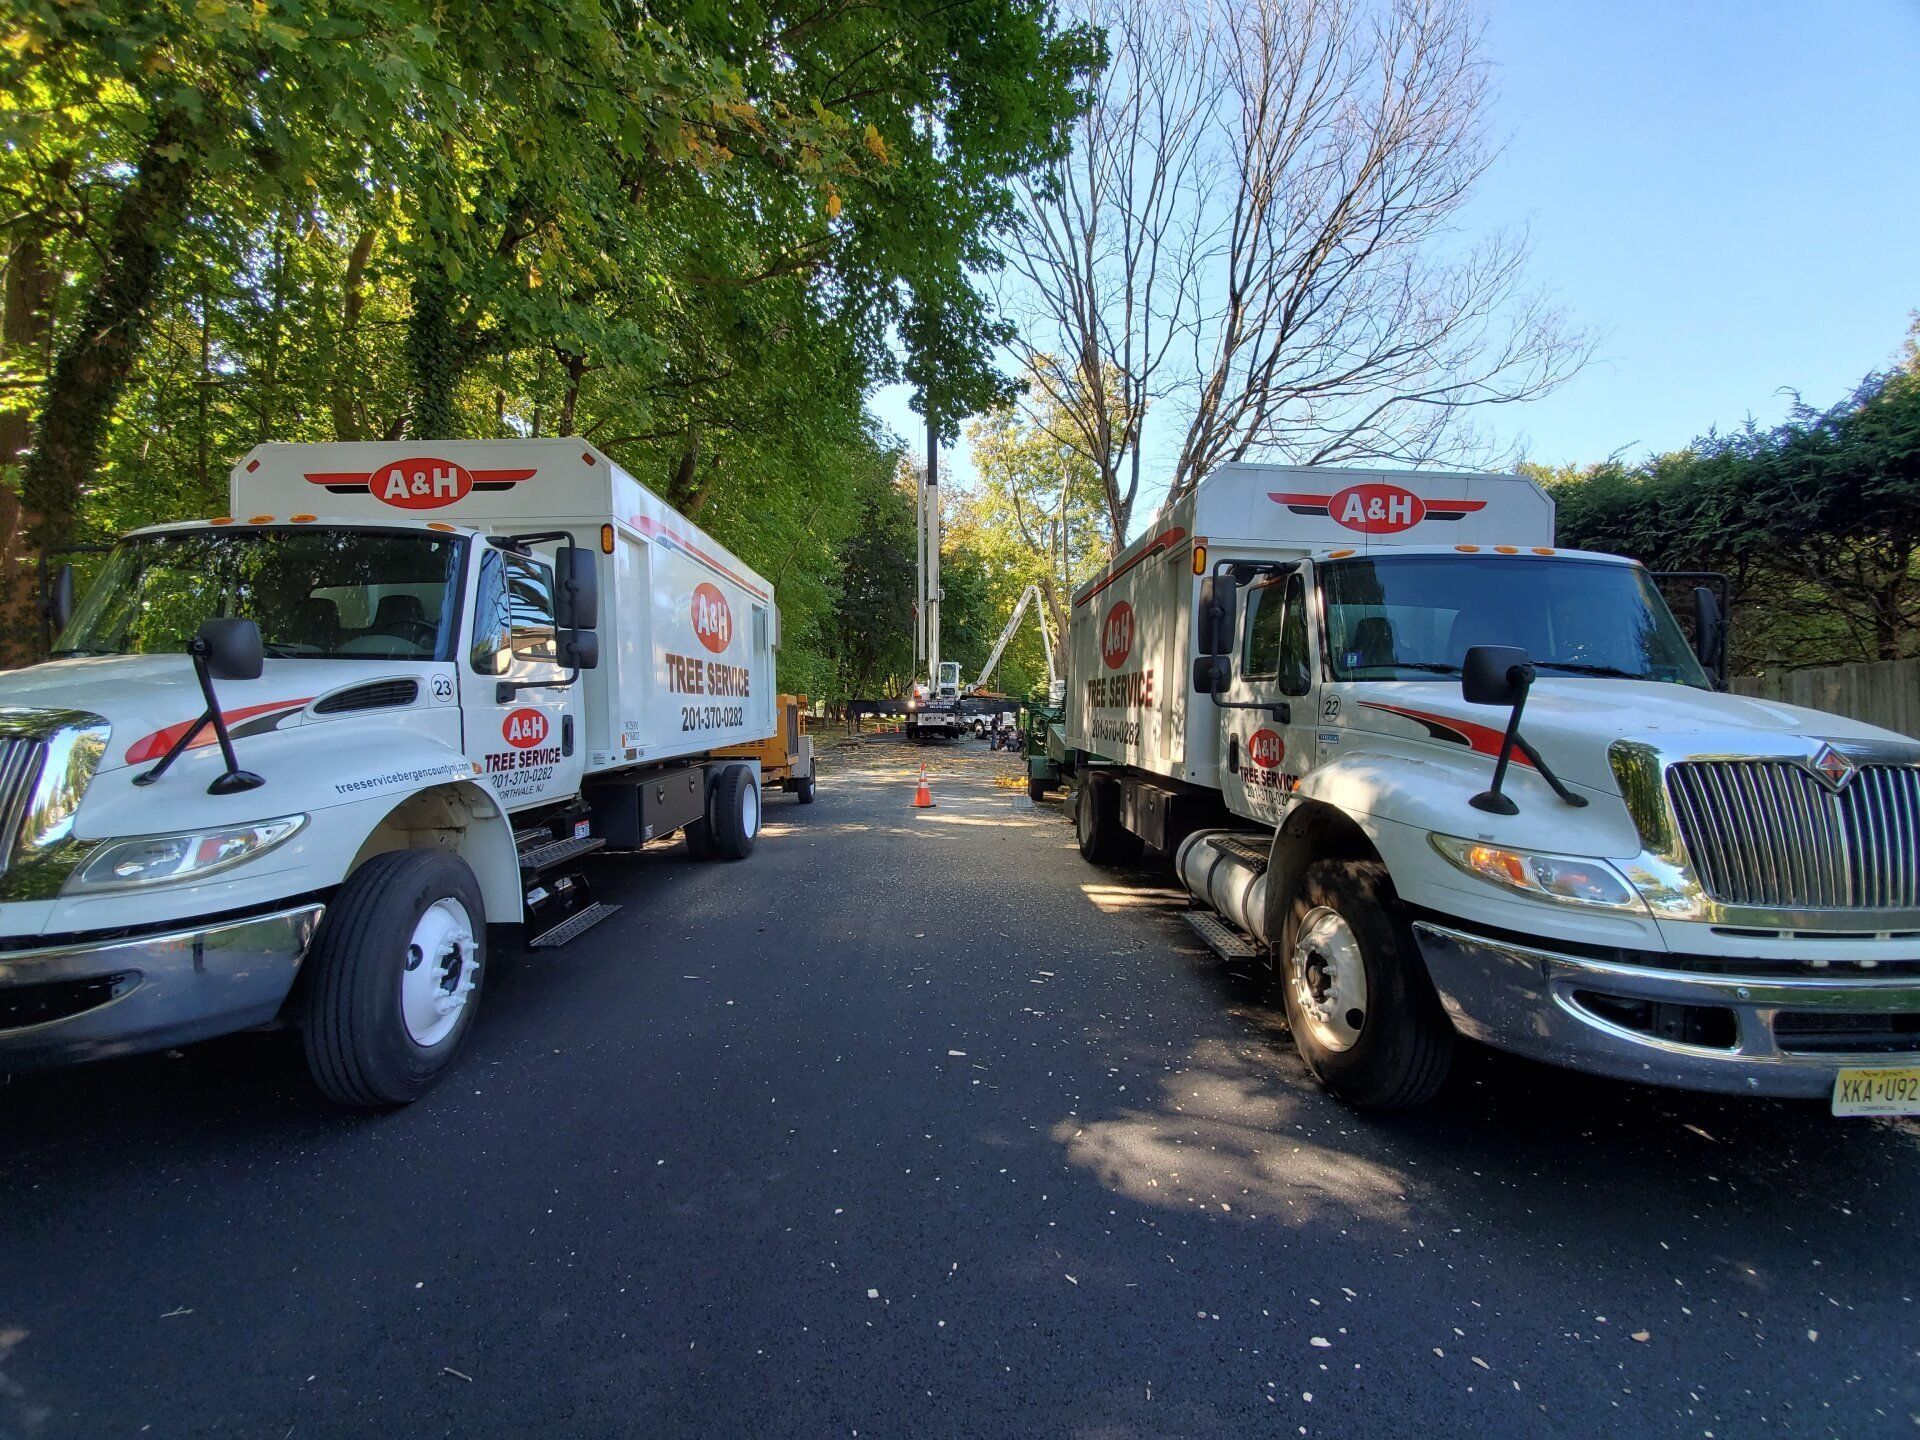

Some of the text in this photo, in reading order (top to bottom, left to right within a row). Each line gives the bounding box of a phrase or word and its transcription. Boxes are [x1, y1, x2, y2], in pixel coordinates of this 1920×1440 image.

[383, 466, 459, 500] A&H
[1341, 493, 1412, 525] A&H
[697, 593, 729, 643] A&H
[1105, 610, 1131, 657] A&H
[433, 680, 452, 696] 23
[665, 653, 750, 698] TREE SERVICE
[1087, 669, 1155, 709] TREE SERVICE
[681, 705, 744, 732] 201-370-0282
[1323, 700, 1339, 716] 22
[508, 716, 544, 741] A&H
[1091, 719, 1140, 747] 201-370-0282
[484, 747, 561, 774] TREE SERVICE
[1252, 736, 1280, 761] A&H
[335, 762, 470, 794] treeservicebergencountynj.com
[491, 766, 554, 789] 201-370-0282
[1239, 766, 1260, 785] TREE
[498, 783, 544, 800] ORTHVALE, NJ
[1246, 785, 1294, 807] 201-370-028
[1840, 1077, 1919, 1103] XKA U92
